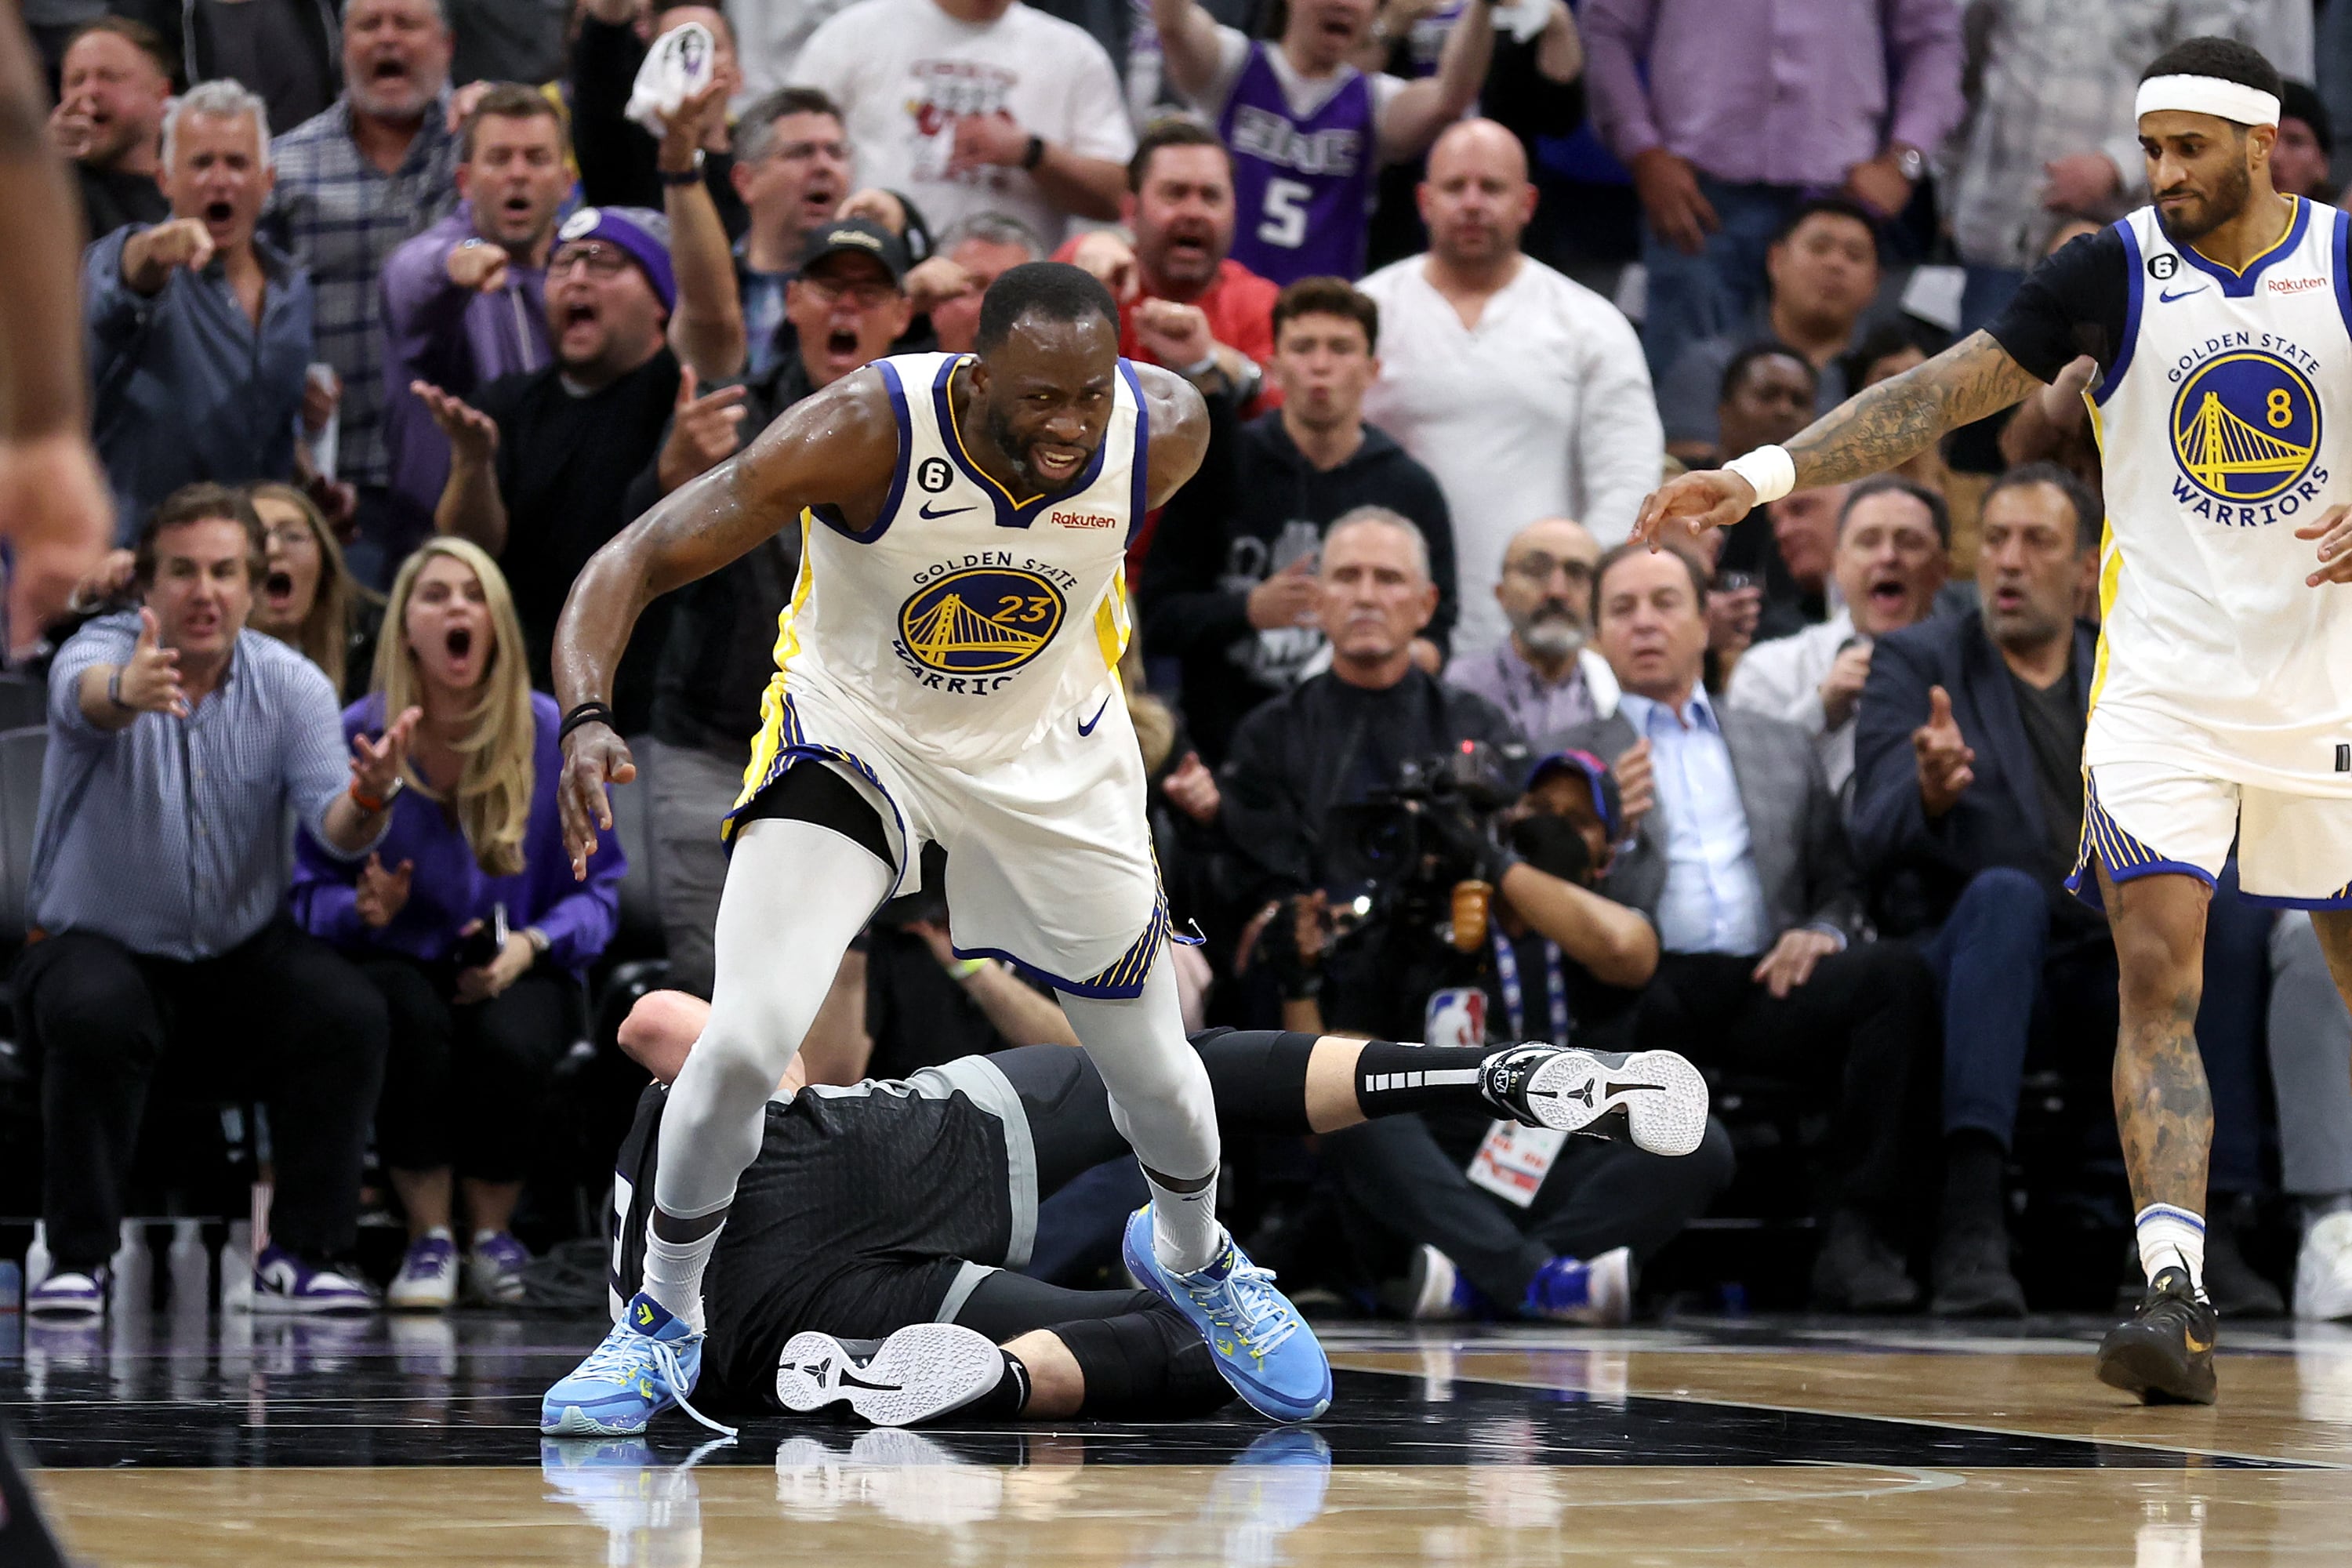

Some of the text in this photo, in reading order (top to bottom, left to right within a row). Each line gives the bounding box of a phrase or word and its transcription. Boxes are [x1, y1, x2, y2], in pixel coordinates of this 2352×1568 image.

[1258, 177, 1312, 249] 5
[2154, 255, 2173, 278] 6
[2268, 277, 2327, 294] Rakuten
[2168, 332, 2321, 383] GOLDEN STATE
[2267, 387, 2293, 429] 8
[924, 462, 946, 489] 6
[2172, 466, 2329, 527] WARRIORS
[1051, 511, 1116, 528] Rakuten
[913, 551, 1078, 590] GOLDEN STATE
[991, 595, 1052, 622] 23
[891, 639, 1021, 696] WARRI
